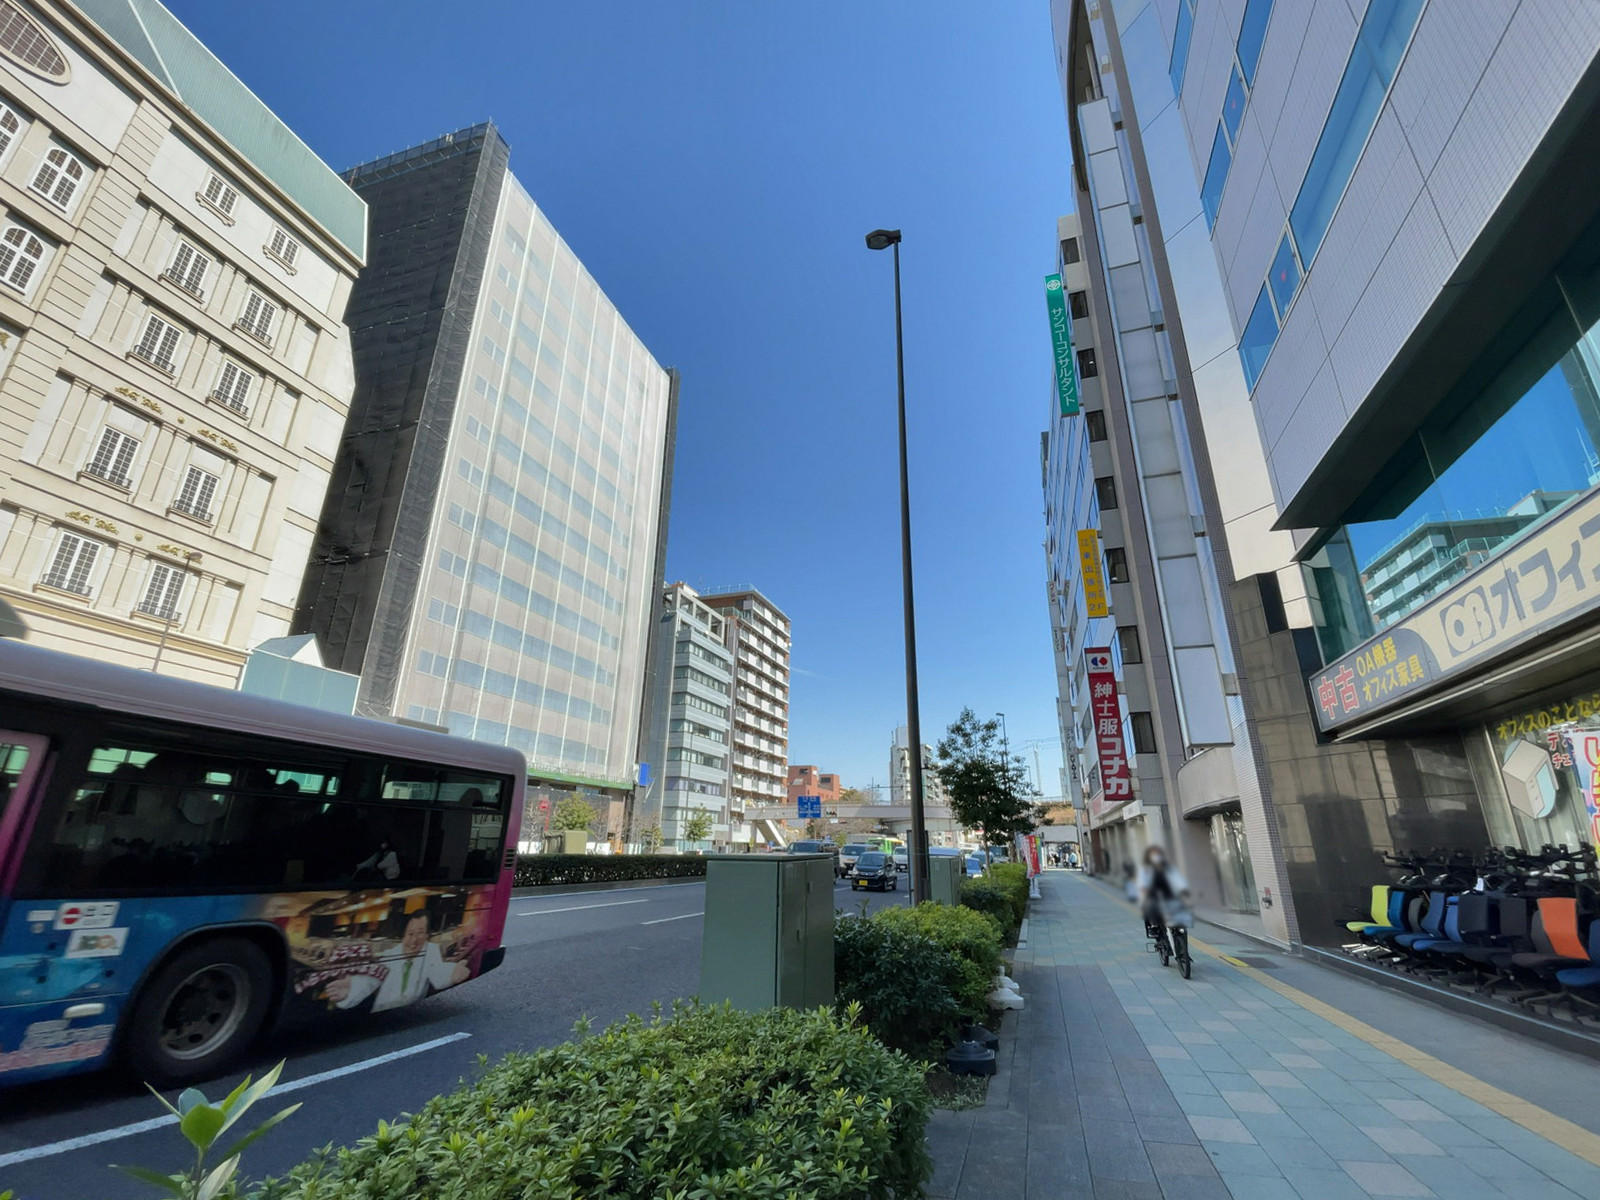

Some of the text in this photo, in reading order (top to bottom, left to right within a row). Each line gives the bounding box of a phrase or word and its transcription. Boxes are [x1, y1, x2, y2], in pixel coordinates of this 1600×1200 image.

[1051, 307, 1075, 407] サンコーコンサルタント
[1490, 513, 1600, 630] オフィ
[1317, 665, 1359, 720] 中古
[1356, 636, 1397, 677] OA機器
[1362, 654, 1424, 702] オフィス家具
[1094, 682, 1130, 795] 紳士服コナカ
